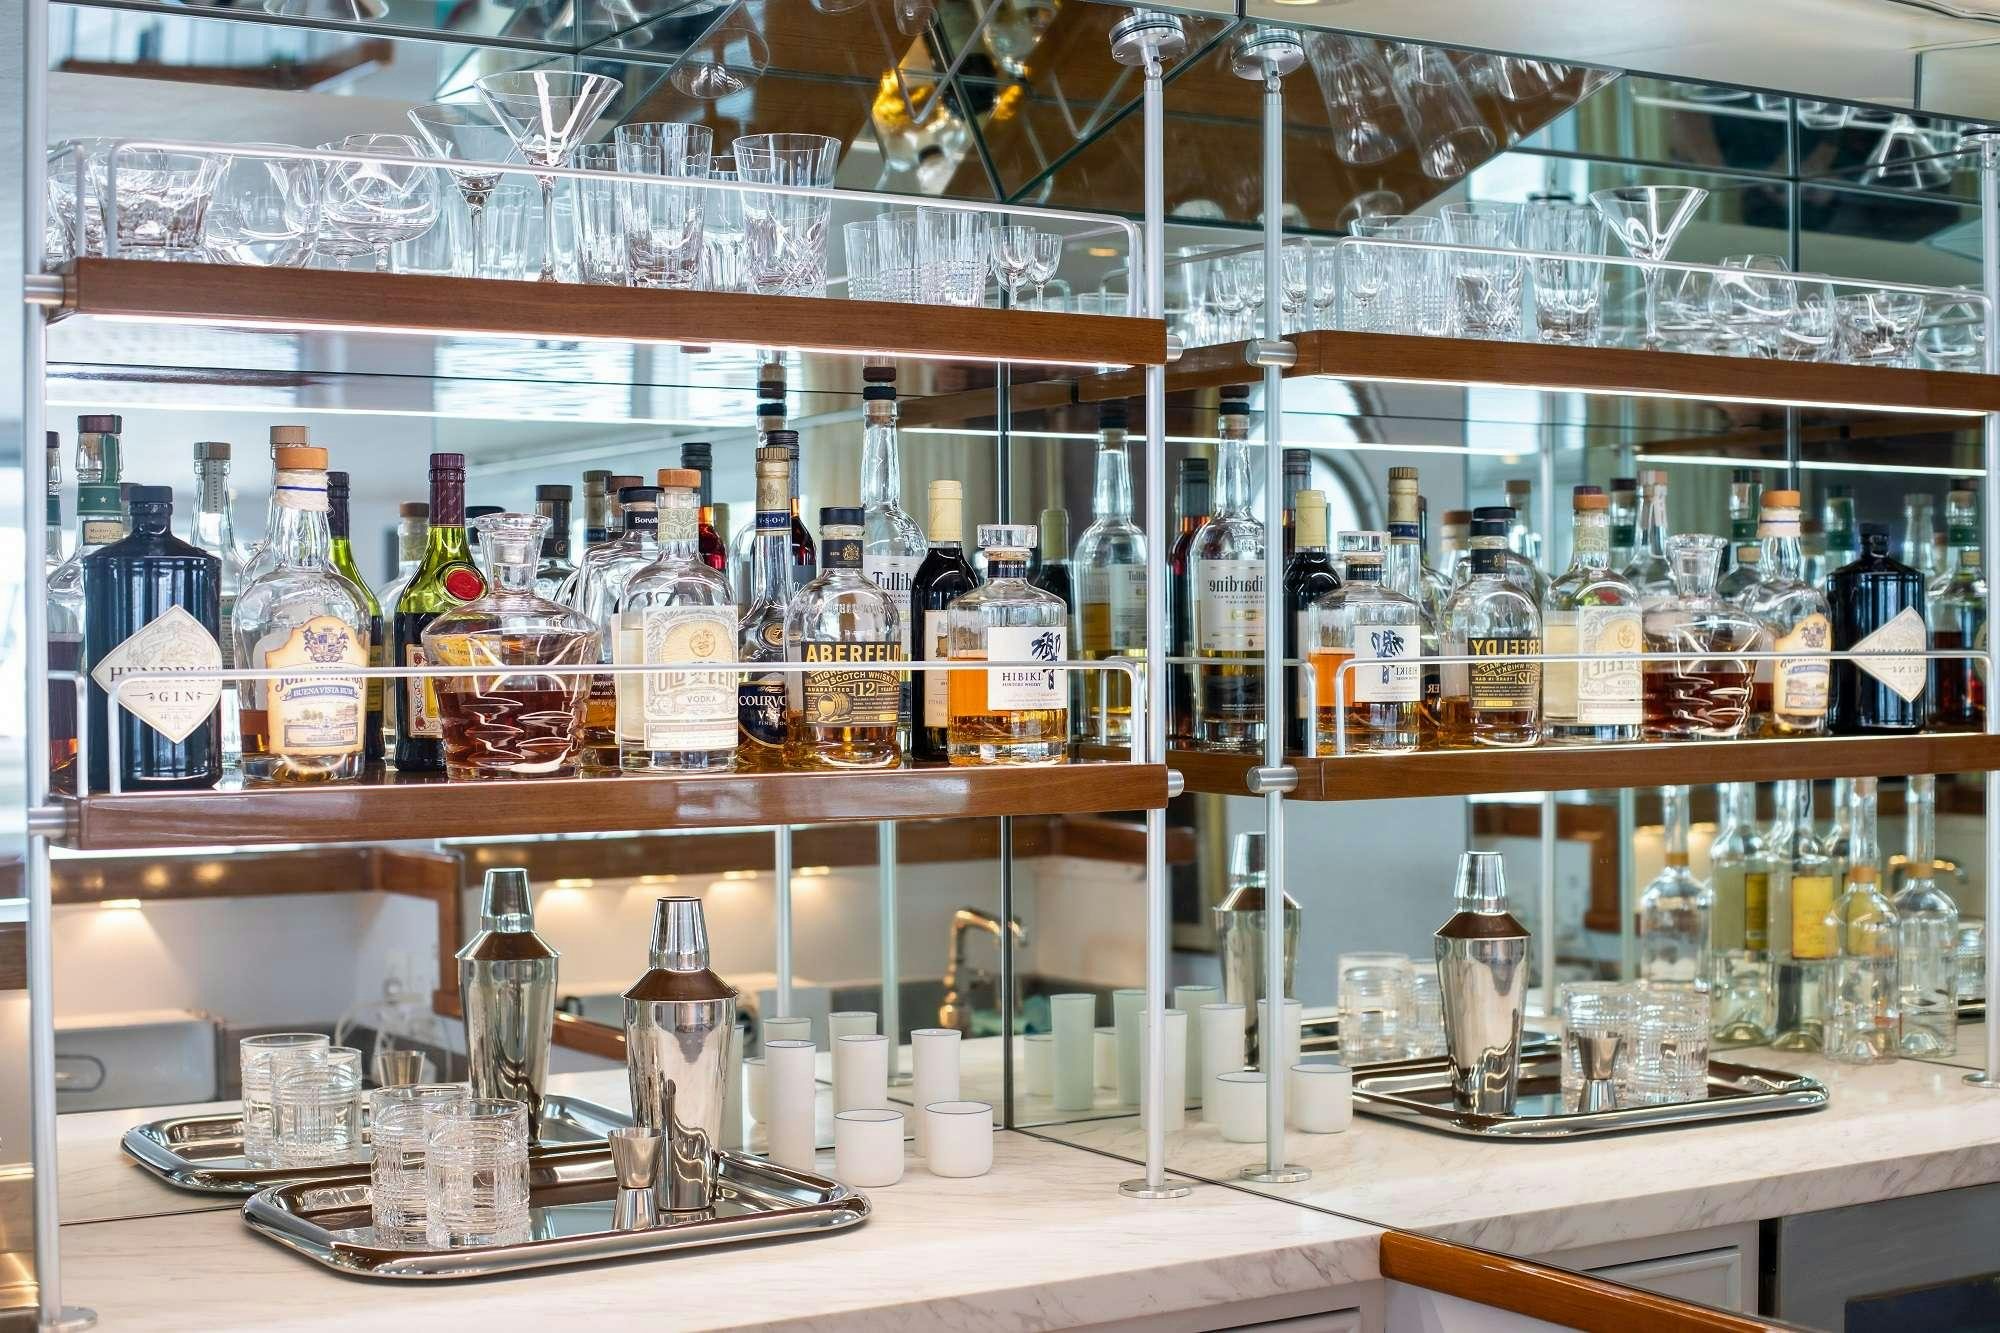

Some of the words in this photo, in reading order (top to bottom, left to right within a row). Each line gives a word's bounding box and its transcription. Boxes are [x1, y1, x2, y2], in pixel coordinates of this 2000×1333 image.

[830, 671, 866, 684] SCOTCH
[1002, 672, 1041, 681] HIBIKI
[857, 681, 876, 697] 12
[159, 691, 195, 702] GIN
